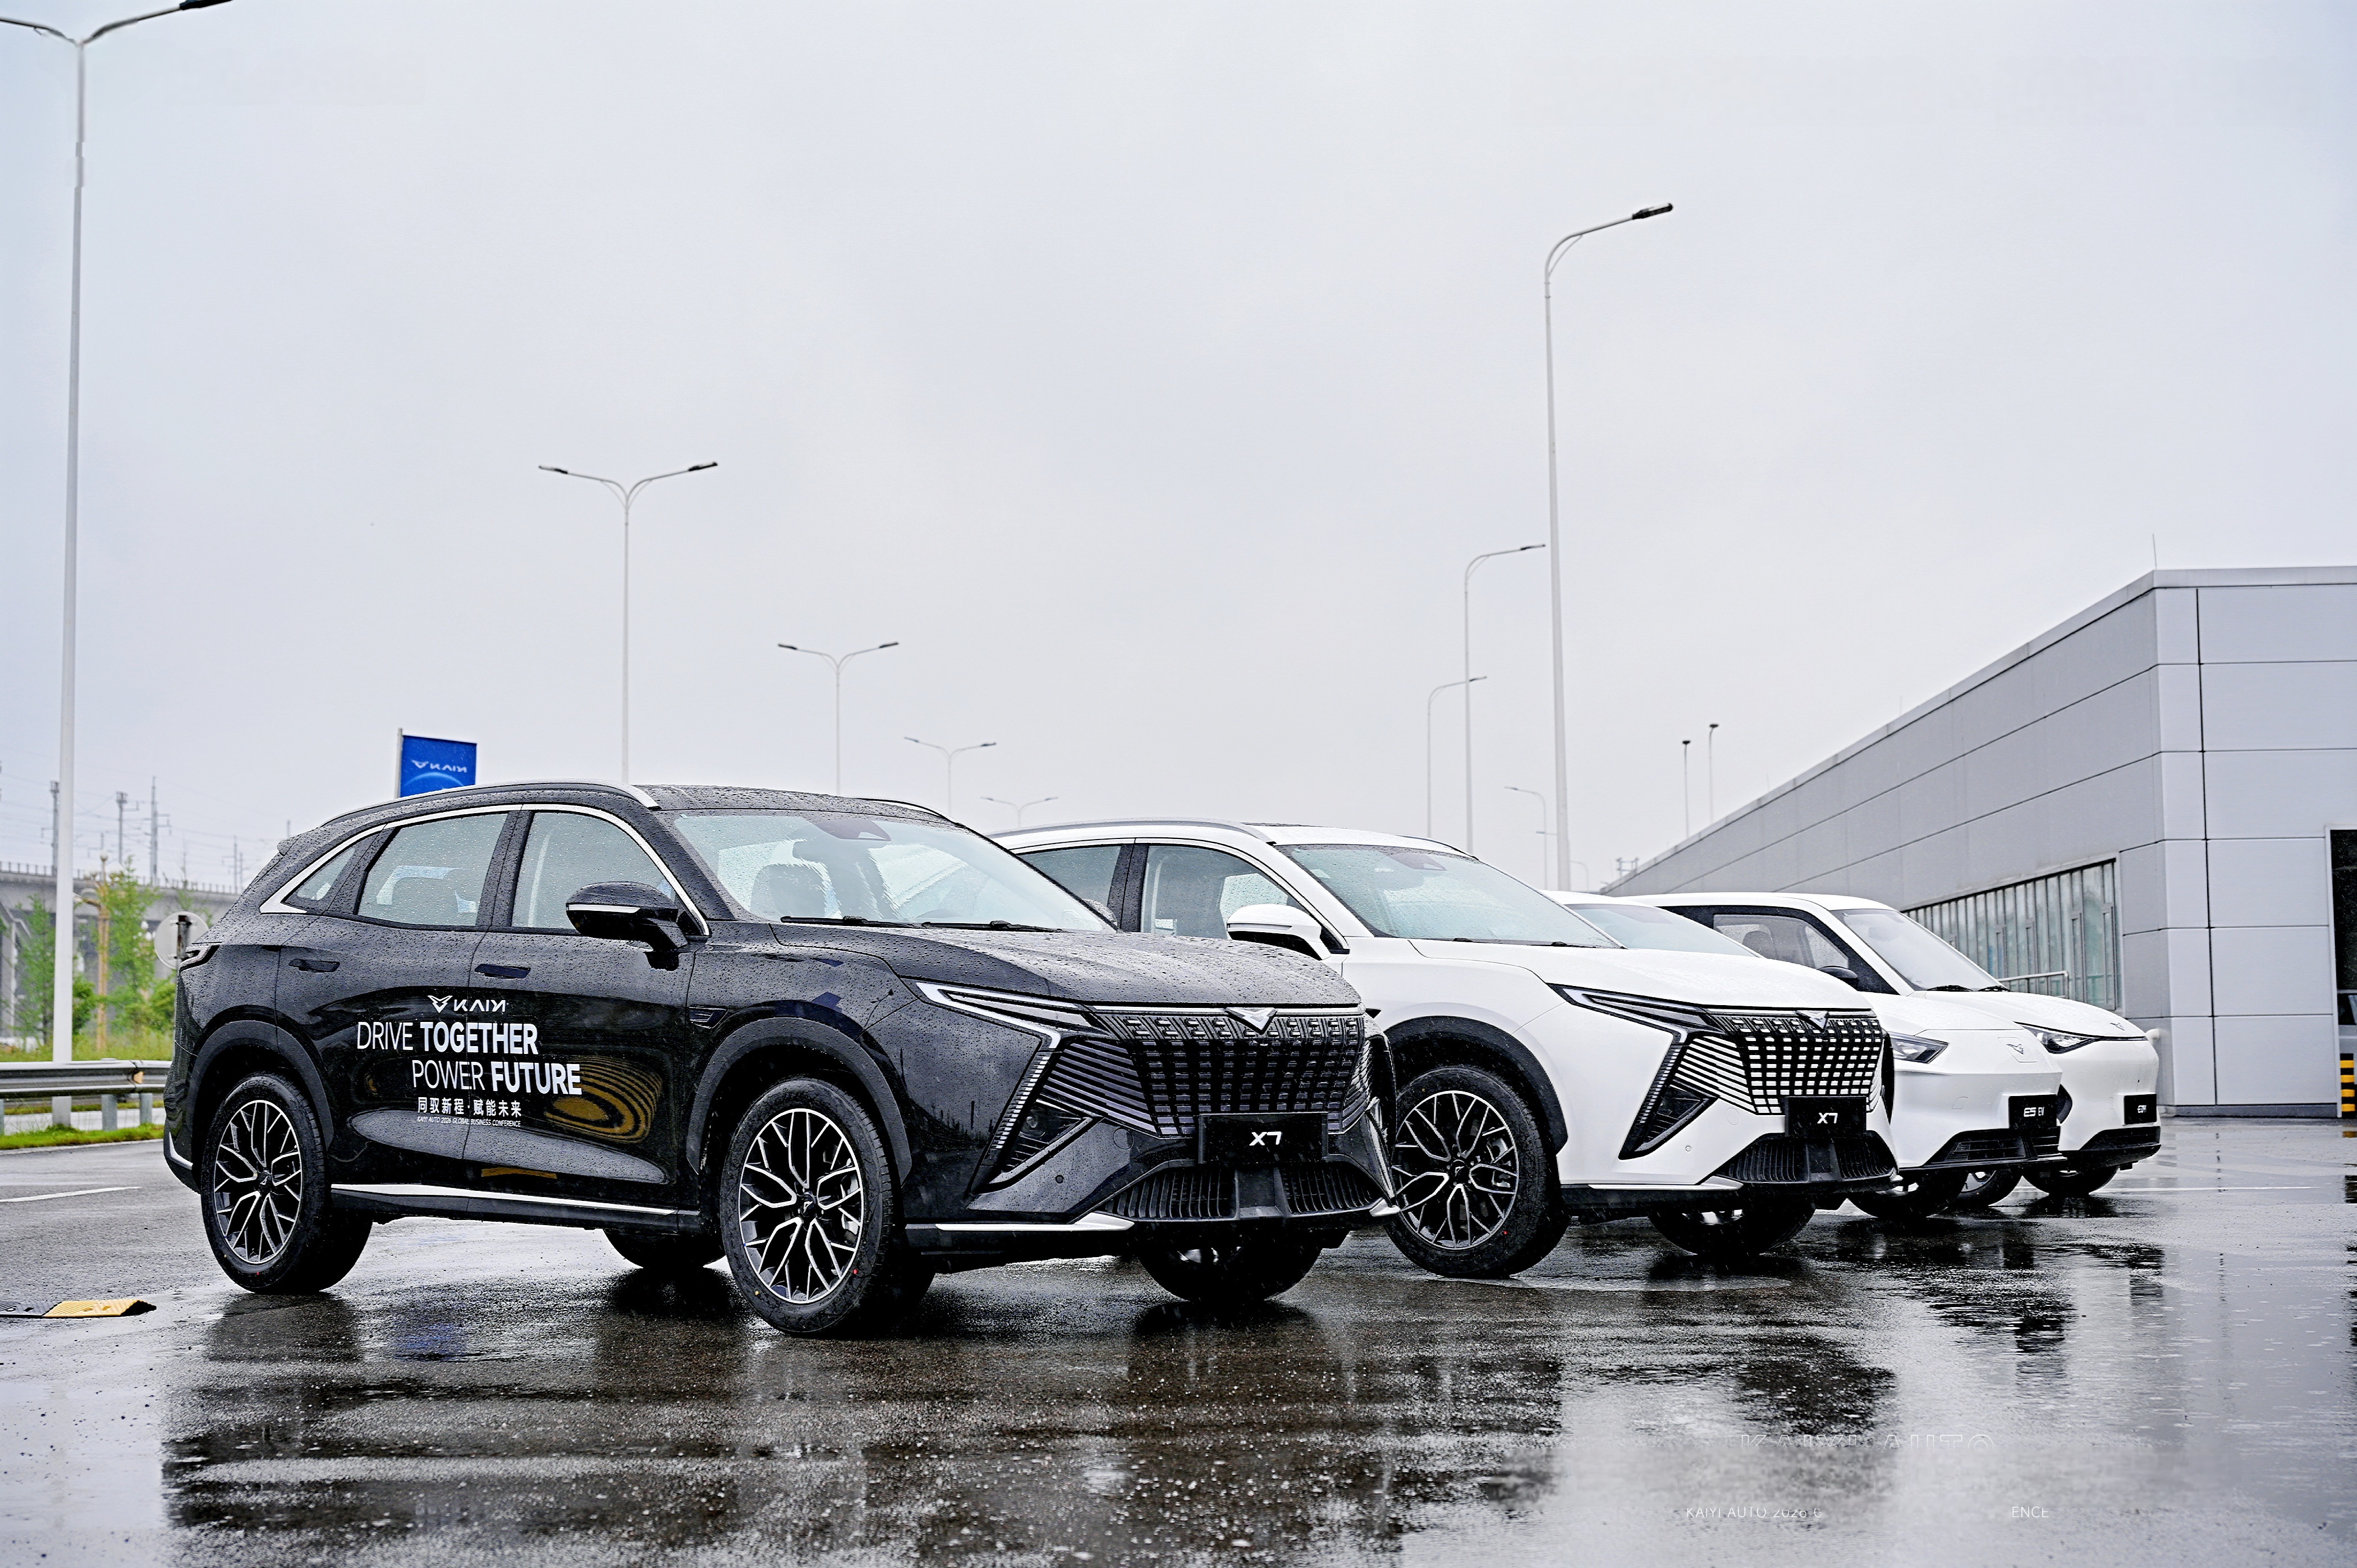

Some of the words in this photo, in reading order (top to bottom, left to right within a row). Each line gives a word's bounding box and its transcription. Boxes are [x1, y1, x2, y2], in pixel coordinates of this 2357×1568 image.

[357, 1021, 414, 1051] DRIVE
[420, 1021, 539, 1054] TOGETHER
[412, 1060, 485, 1090] POWER
[490, 1061, 582, 1095] FUTURE
[492, 1119, 521, 1127] CONFERENCE
[1817, 1112, 1838, 1124] X7
[1249, 1131, 1282, 1146] X7
